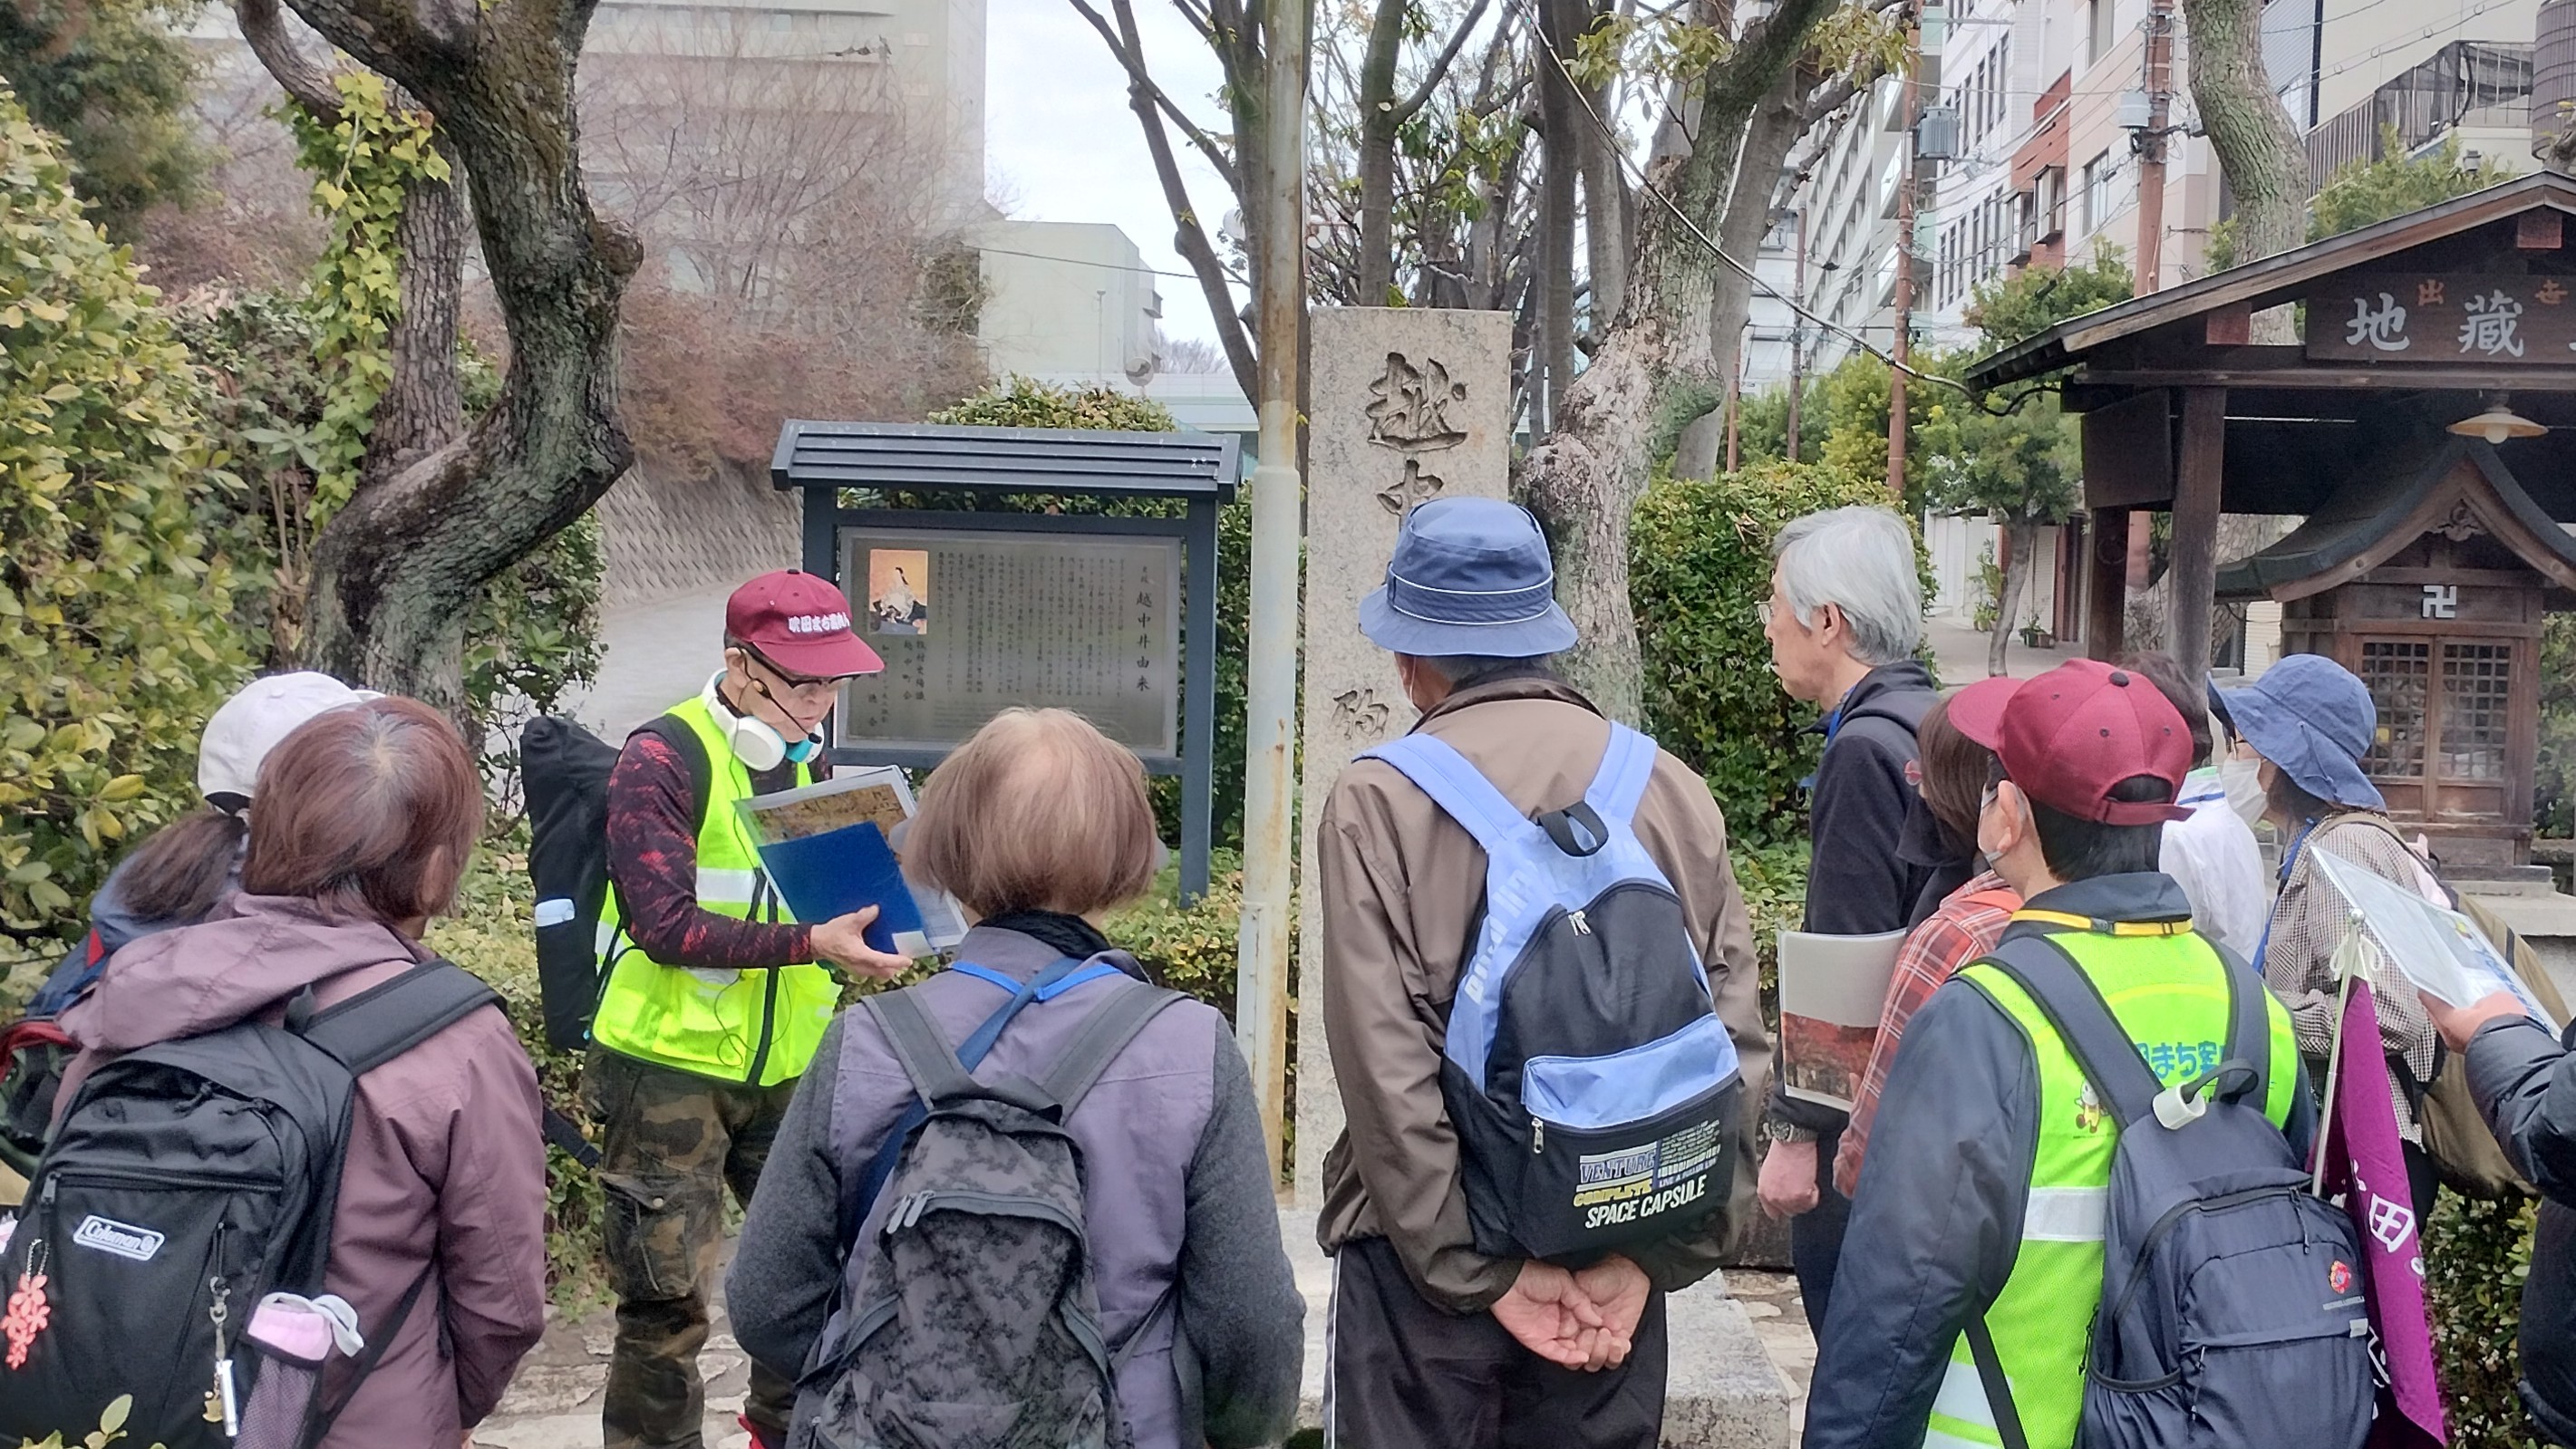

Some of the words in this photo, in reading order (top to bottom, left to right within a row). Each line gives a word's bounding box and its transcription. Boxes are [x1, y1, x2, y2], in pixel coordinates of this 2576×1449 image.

[1136, 591, 1153, 692] 越中井由来
[2135, 1040, 2225, 1079] まち案
[1580, 1148, 1657, 1184] VENTURE
[1585, 1199, 1640, 1229] SPACE
[1640, 1174, 1708, 1218] CAPSULE
[84, 1221, 142, 1250] Coleman
